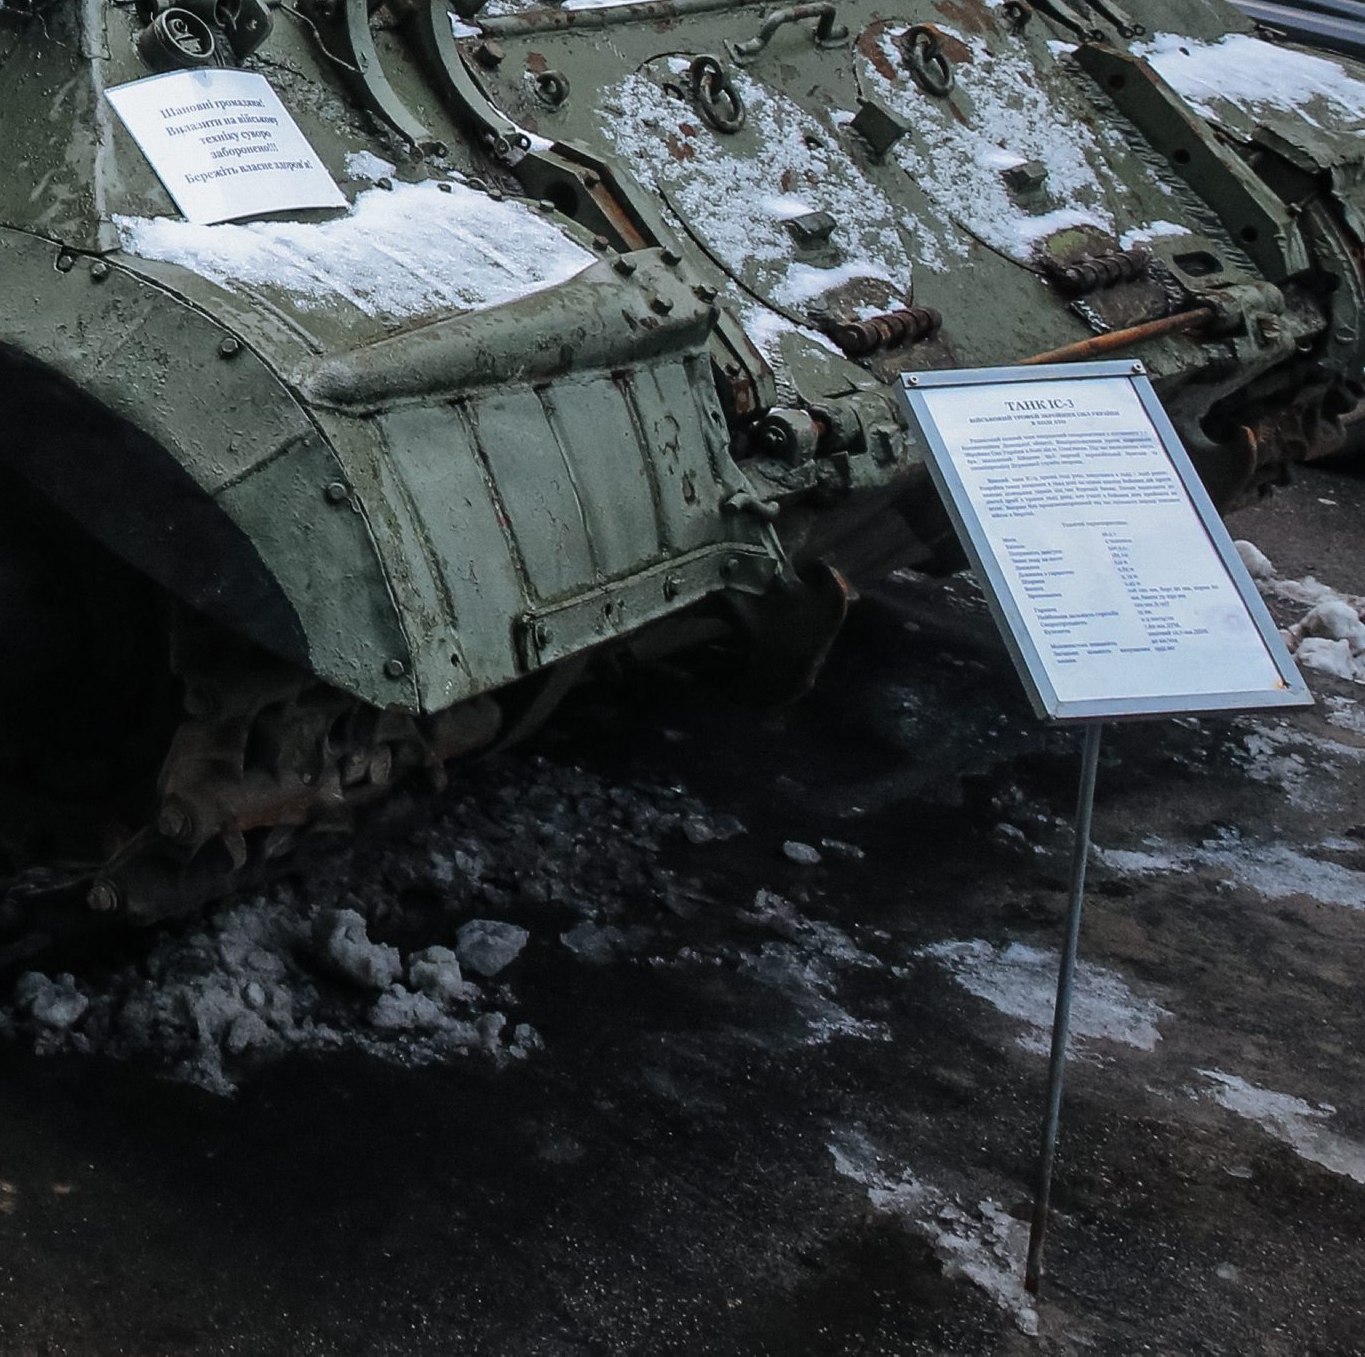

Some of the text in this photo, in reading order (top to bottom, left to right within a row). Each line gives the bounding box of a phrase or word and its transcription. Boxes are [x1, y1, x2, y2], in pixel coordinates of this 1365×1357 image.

[159, 99, 214, 119] Шановні
[165, 118, 223, 137] Вилазити
[199, 129, 240, 145] техніку
[209, 142, 279, 160] заборонено!!!
[184, 165, 240, 184] Бережіть
[1004, 399, 1047, 412] ТАНК
